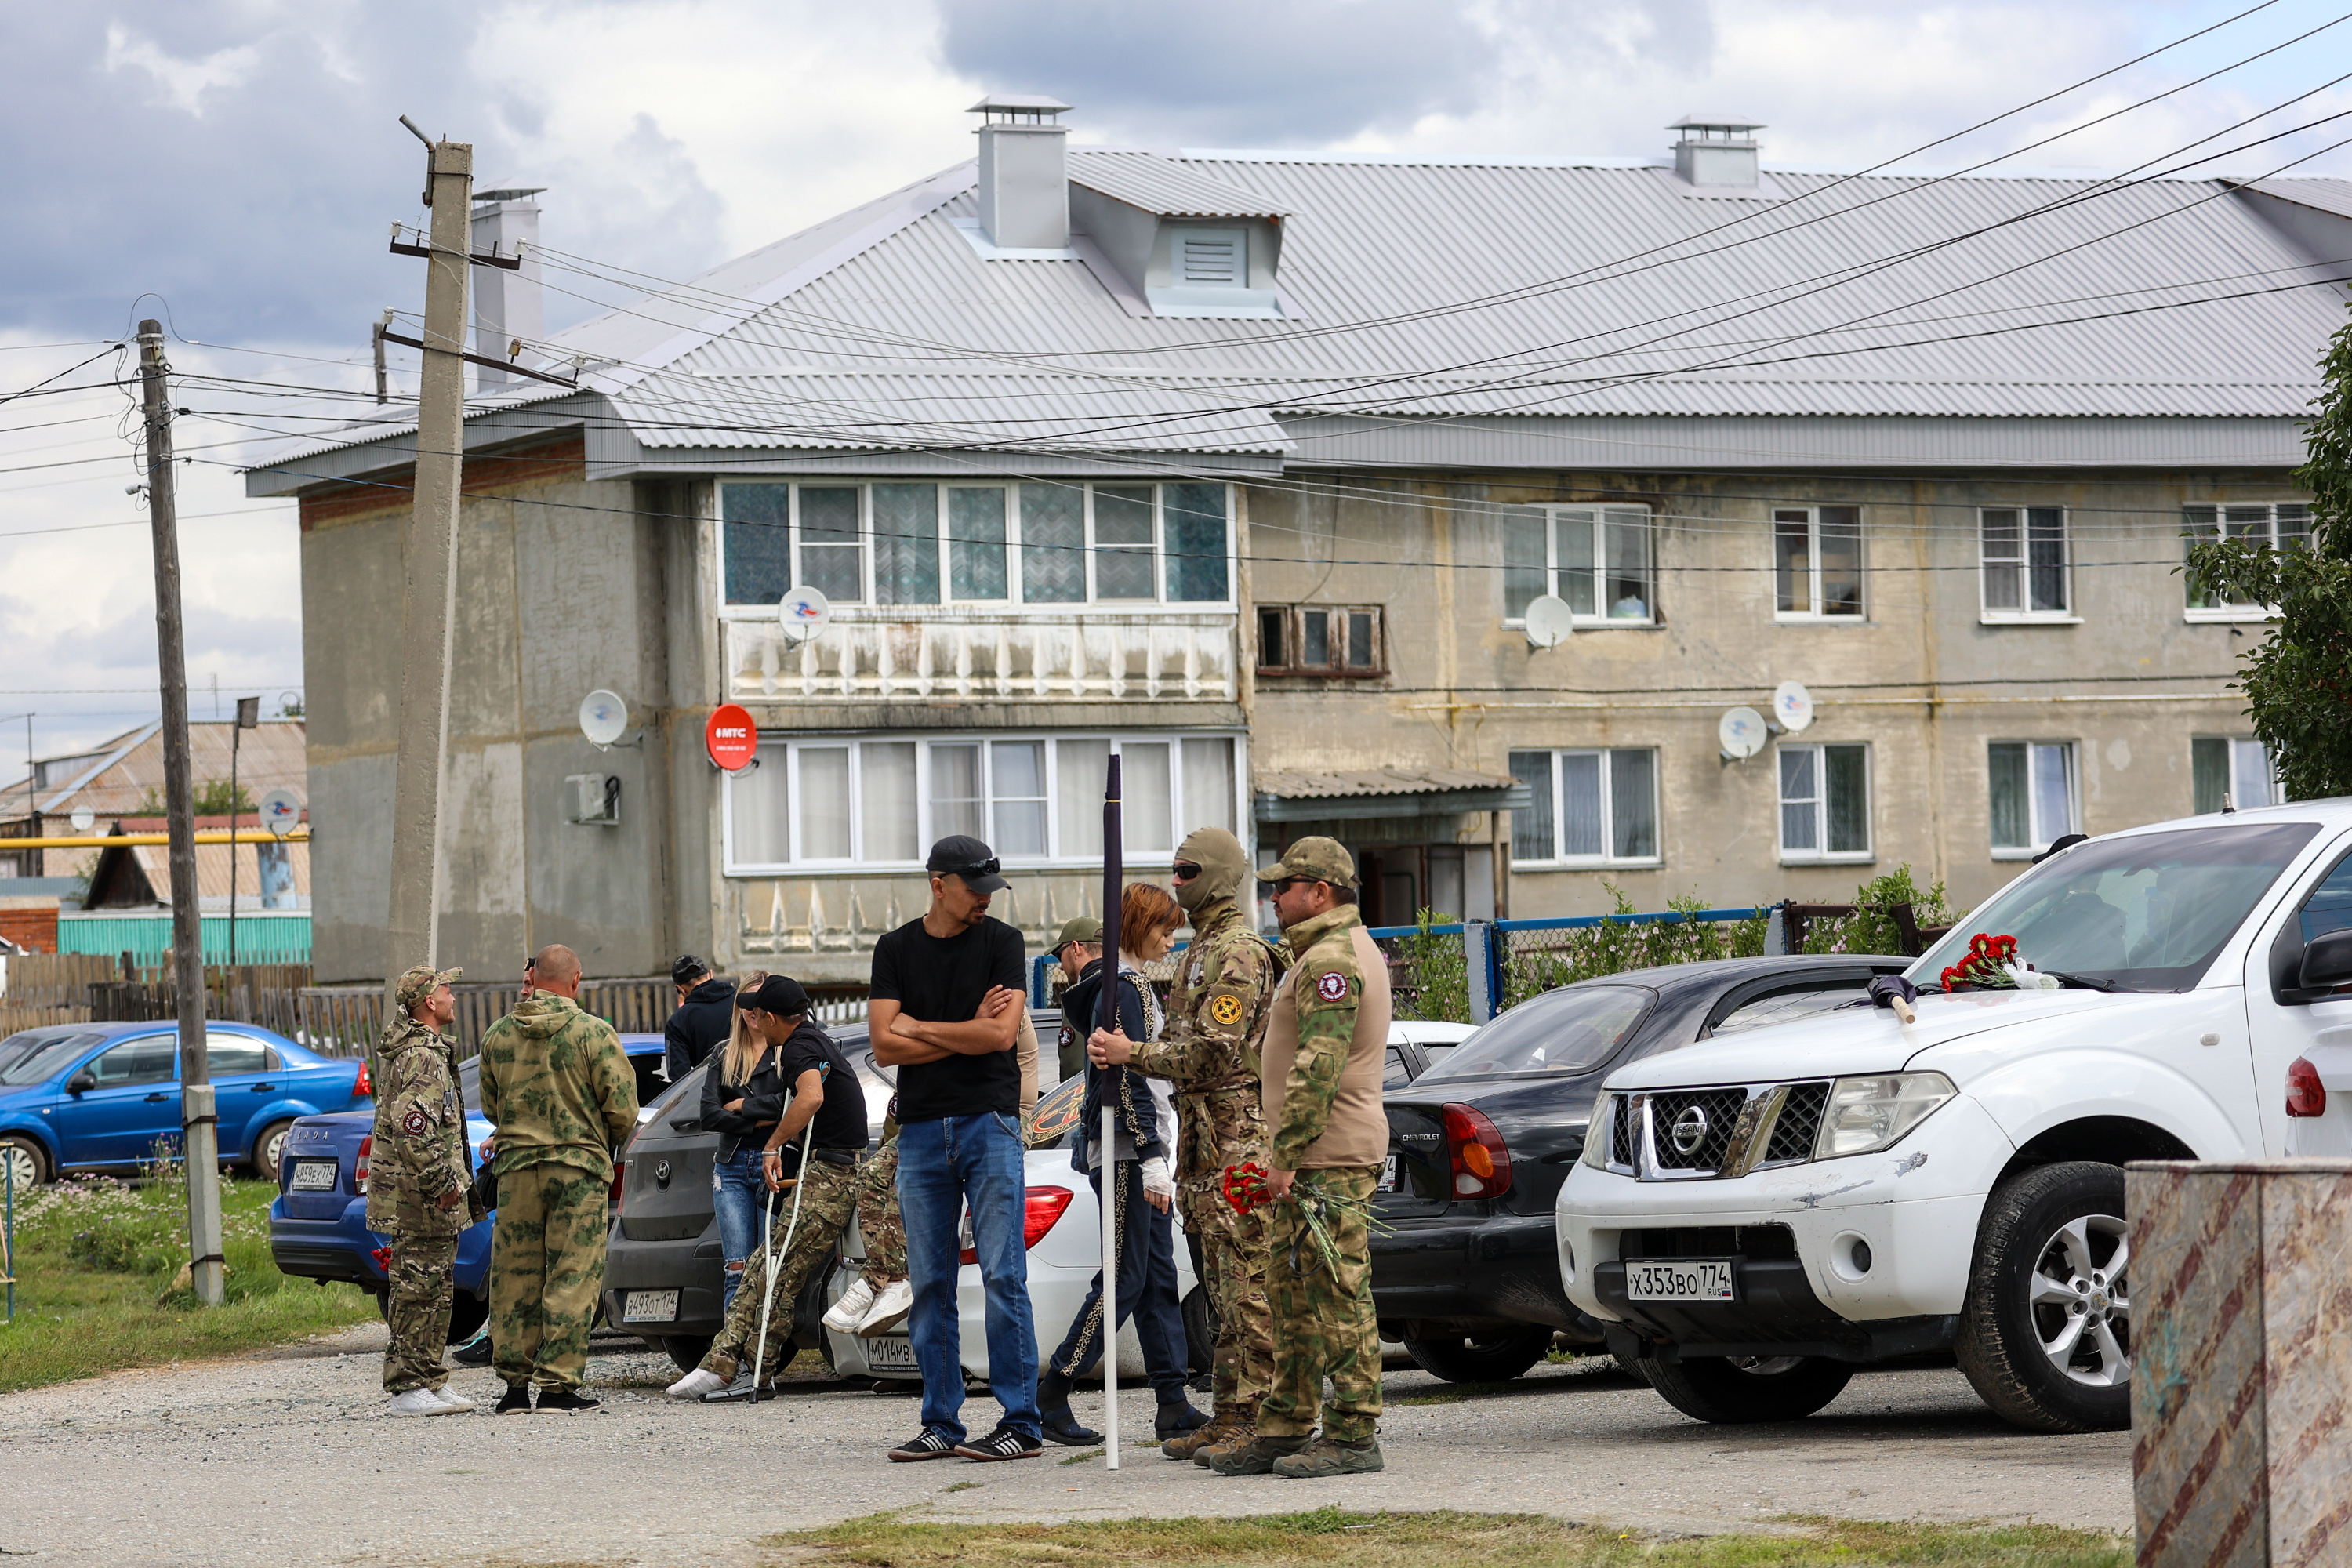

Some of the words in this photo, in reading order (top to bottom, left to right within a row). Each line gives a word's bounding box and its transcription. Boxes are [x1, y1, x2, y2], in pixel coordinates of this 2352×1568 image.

[721, 728, 746, 738] МТС
[297, 1131, 328, 1141] LADA
[1402, 1133, 1441, 1142] CHEVROLET
[1700, 1265, 1728, 1287] 774
[662, 1292, 676, 1308] 174
